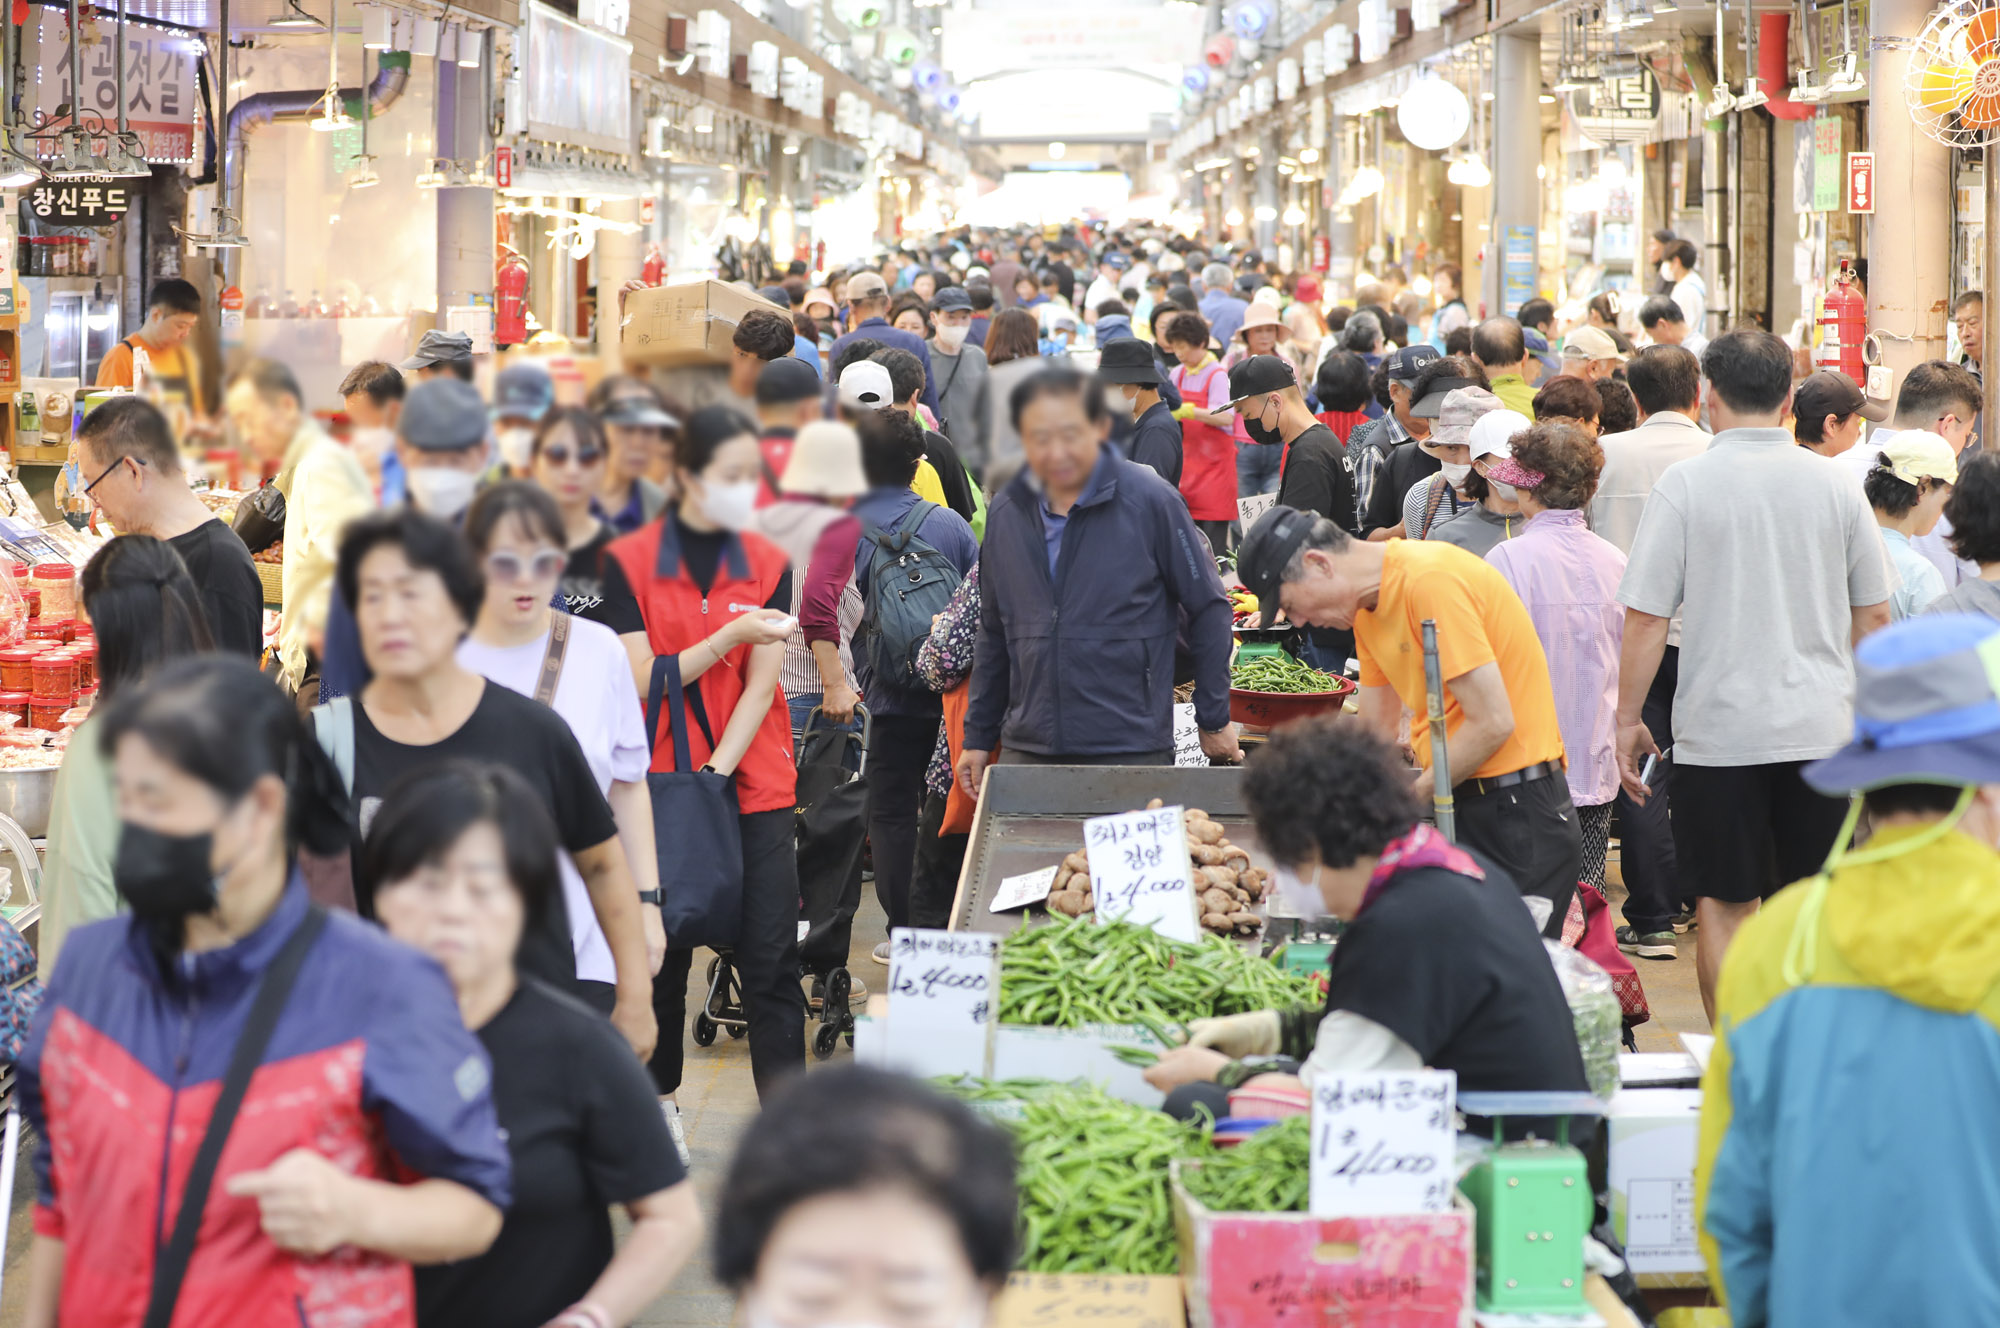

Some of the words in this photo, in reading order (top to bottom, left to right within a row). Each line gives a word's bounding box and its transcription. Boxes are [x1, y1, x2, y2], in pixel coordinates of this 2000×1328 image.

[56, 31, 184, 115] 신광젓갈
[1853, 158, 1870, 166] 소화기
[48, 175, 82, 183] SUPER
[84, 175, 114, 183] FOOD
[33, 188, 128, 216] 창신푸드
